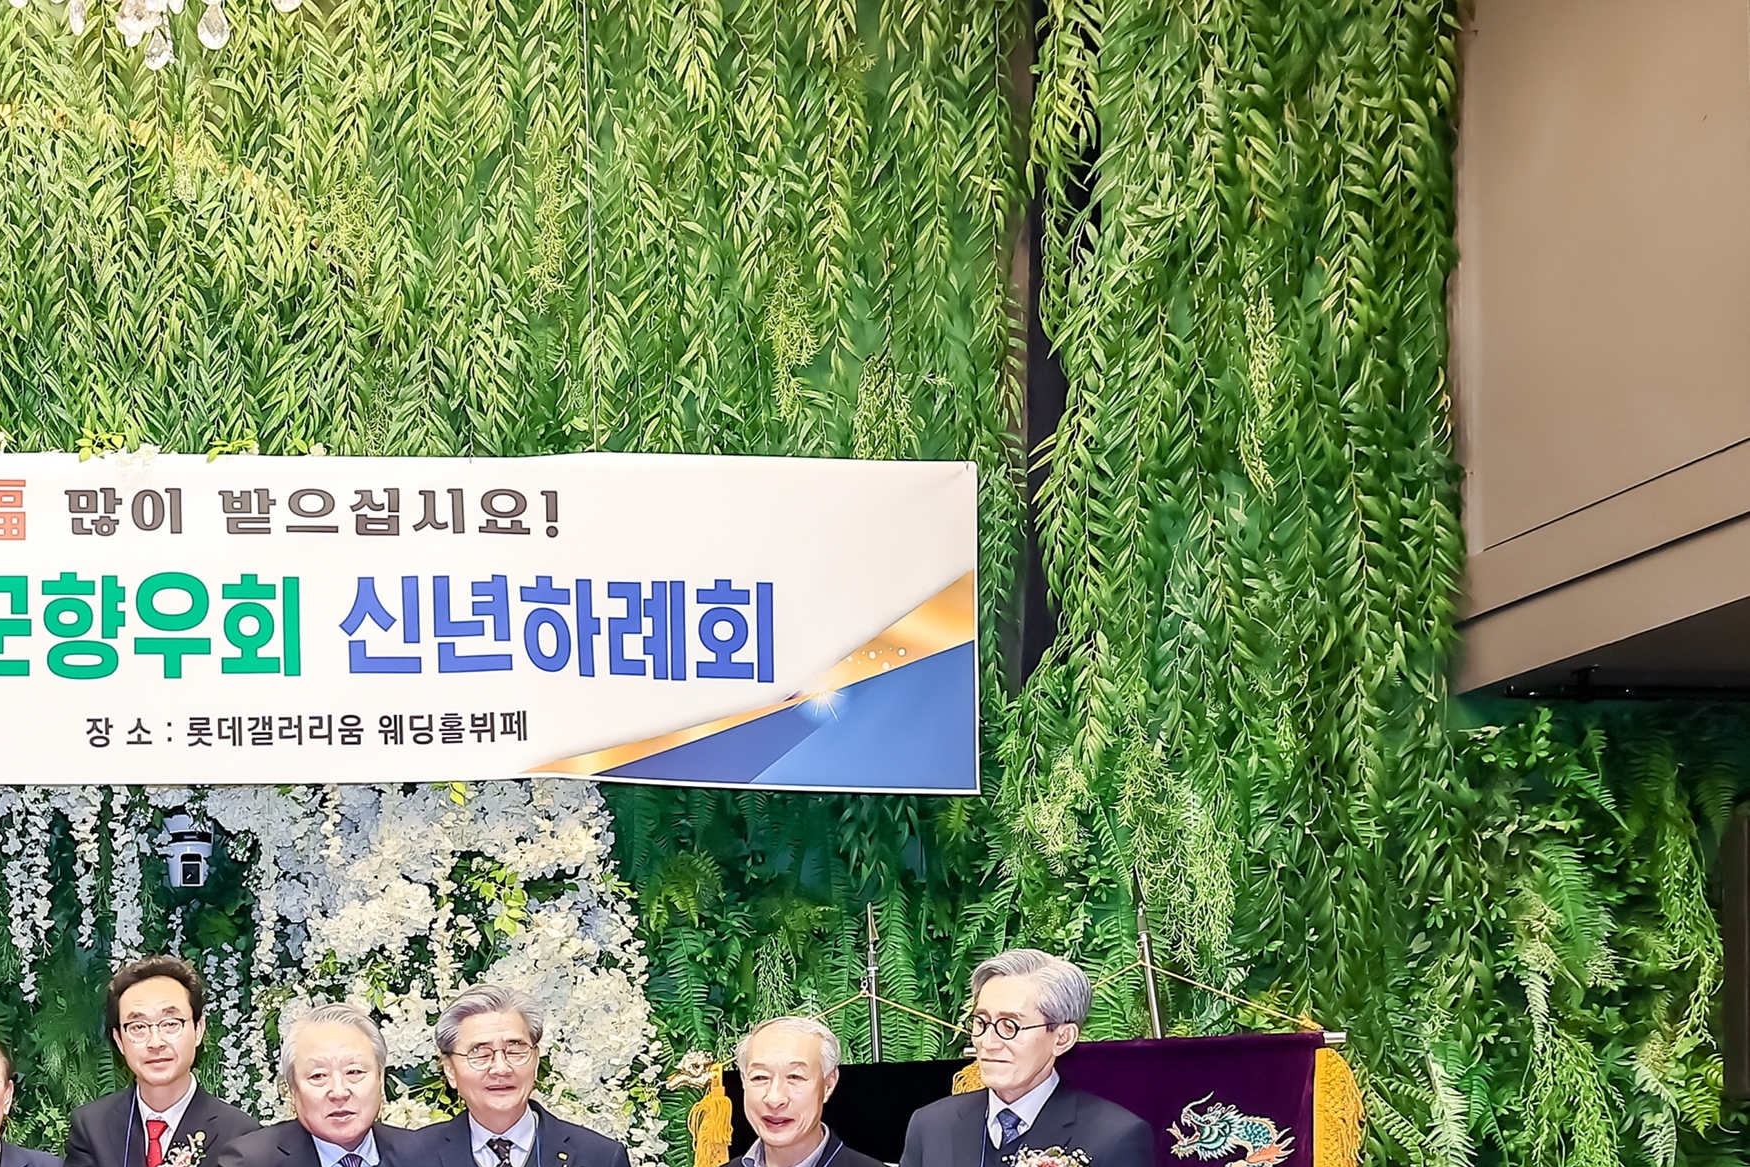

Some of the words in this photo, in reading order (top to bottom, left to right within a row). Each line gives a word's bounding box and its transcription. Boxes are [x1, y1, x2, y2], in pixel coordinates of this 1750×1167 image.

[64, 487, 183, 537] 많이
[217, 487, 559, 539] 받으십시요!
[338, 573, 775, 684] 신년하례회
[186, 714, 364, 747] 롯데갤러리움
[377, 710, 528, 746] 웨딩홀뷔페
